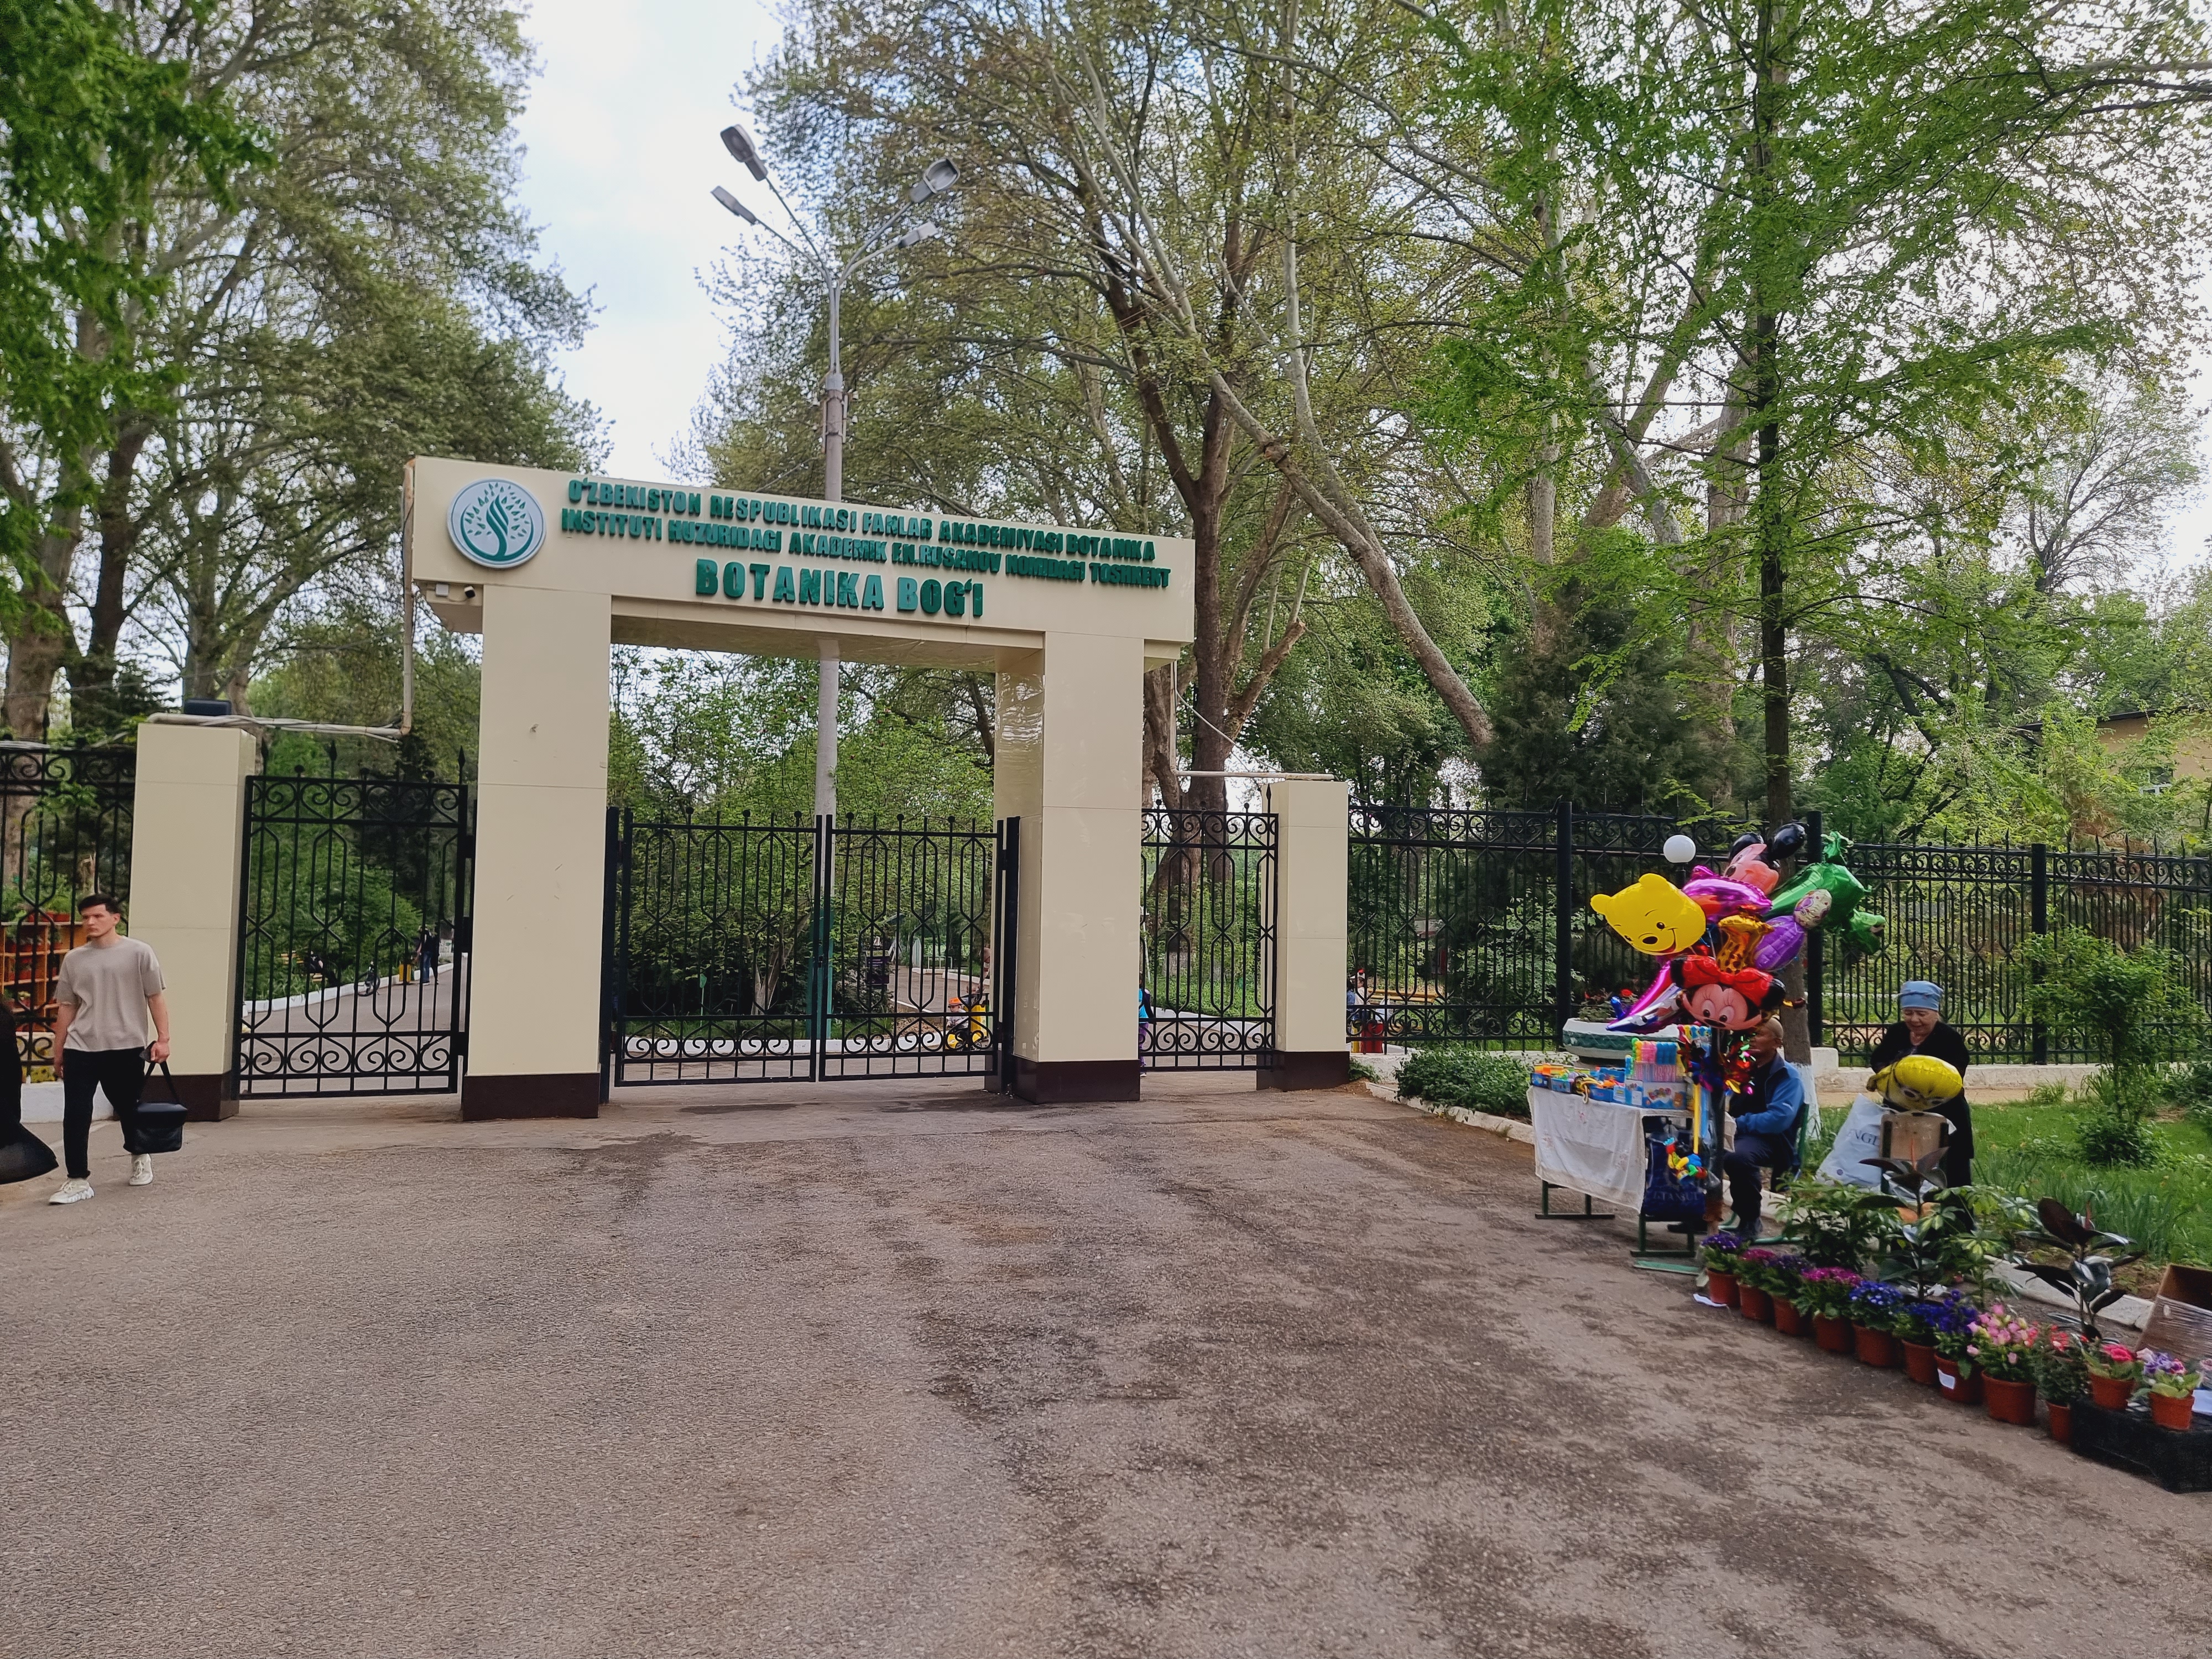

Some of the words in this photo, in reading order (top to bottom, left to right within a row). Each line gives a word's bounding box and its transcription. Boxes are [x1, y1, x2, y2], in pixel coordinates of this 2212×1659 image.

[561, 508, 663, 540] INSTITUTI
[668, 519, 783, 552] HUZURIDAGI
[789, 531, 888, 561] AKADEMIK
[1005, 554, 1086, 581] NOMIDAGI
[1089, 561, 1171, 587] TOSHKENT
[710, 494, 858, 530] RESPUBLIKASI
[863, 512, 933, 538] FANLAR
[938, 520, 1065, 552] AKADEMIYASI
[1066, 533, 1156, 561] BOTANIKA
[696, 558, 885, 609] BOTANIKA
[897, 576, 984, 617] BOG‘I
